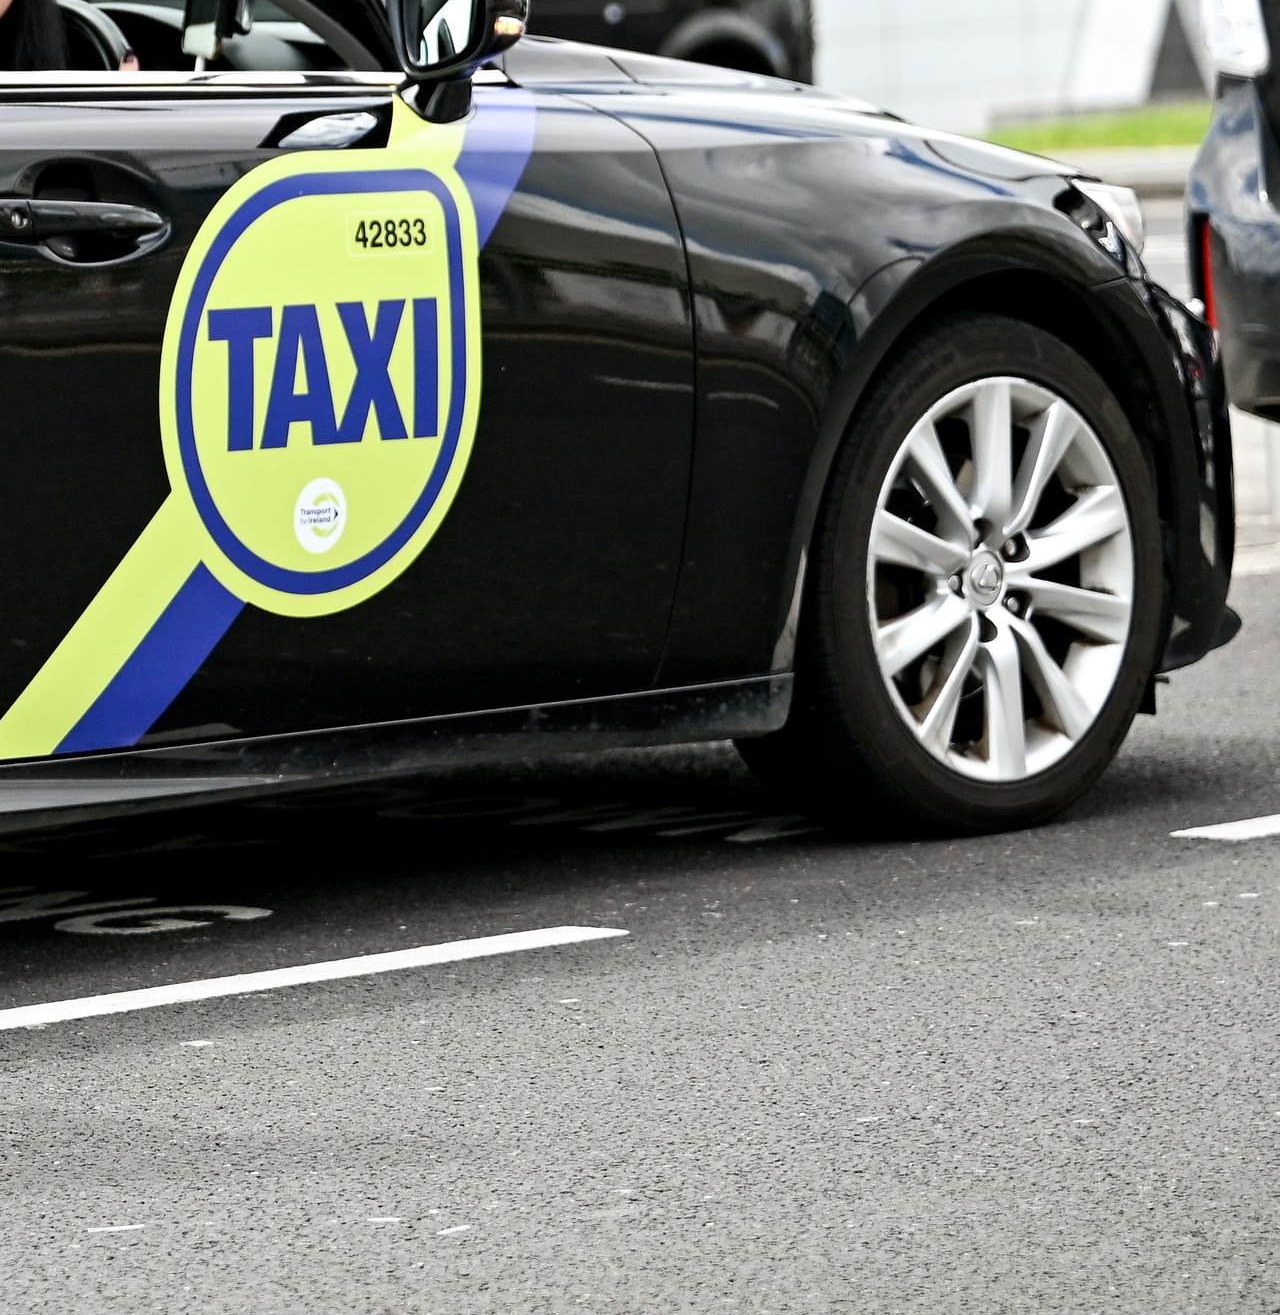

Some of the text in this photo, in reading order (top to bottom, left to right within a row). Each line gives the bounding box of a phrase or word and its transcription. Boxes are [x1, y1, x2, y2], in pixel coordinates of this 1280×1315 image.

[354, 217, 428, 249] 42833
[207, 296, 438, 452] TAXI
[300, 507, 332, 516] Transport
